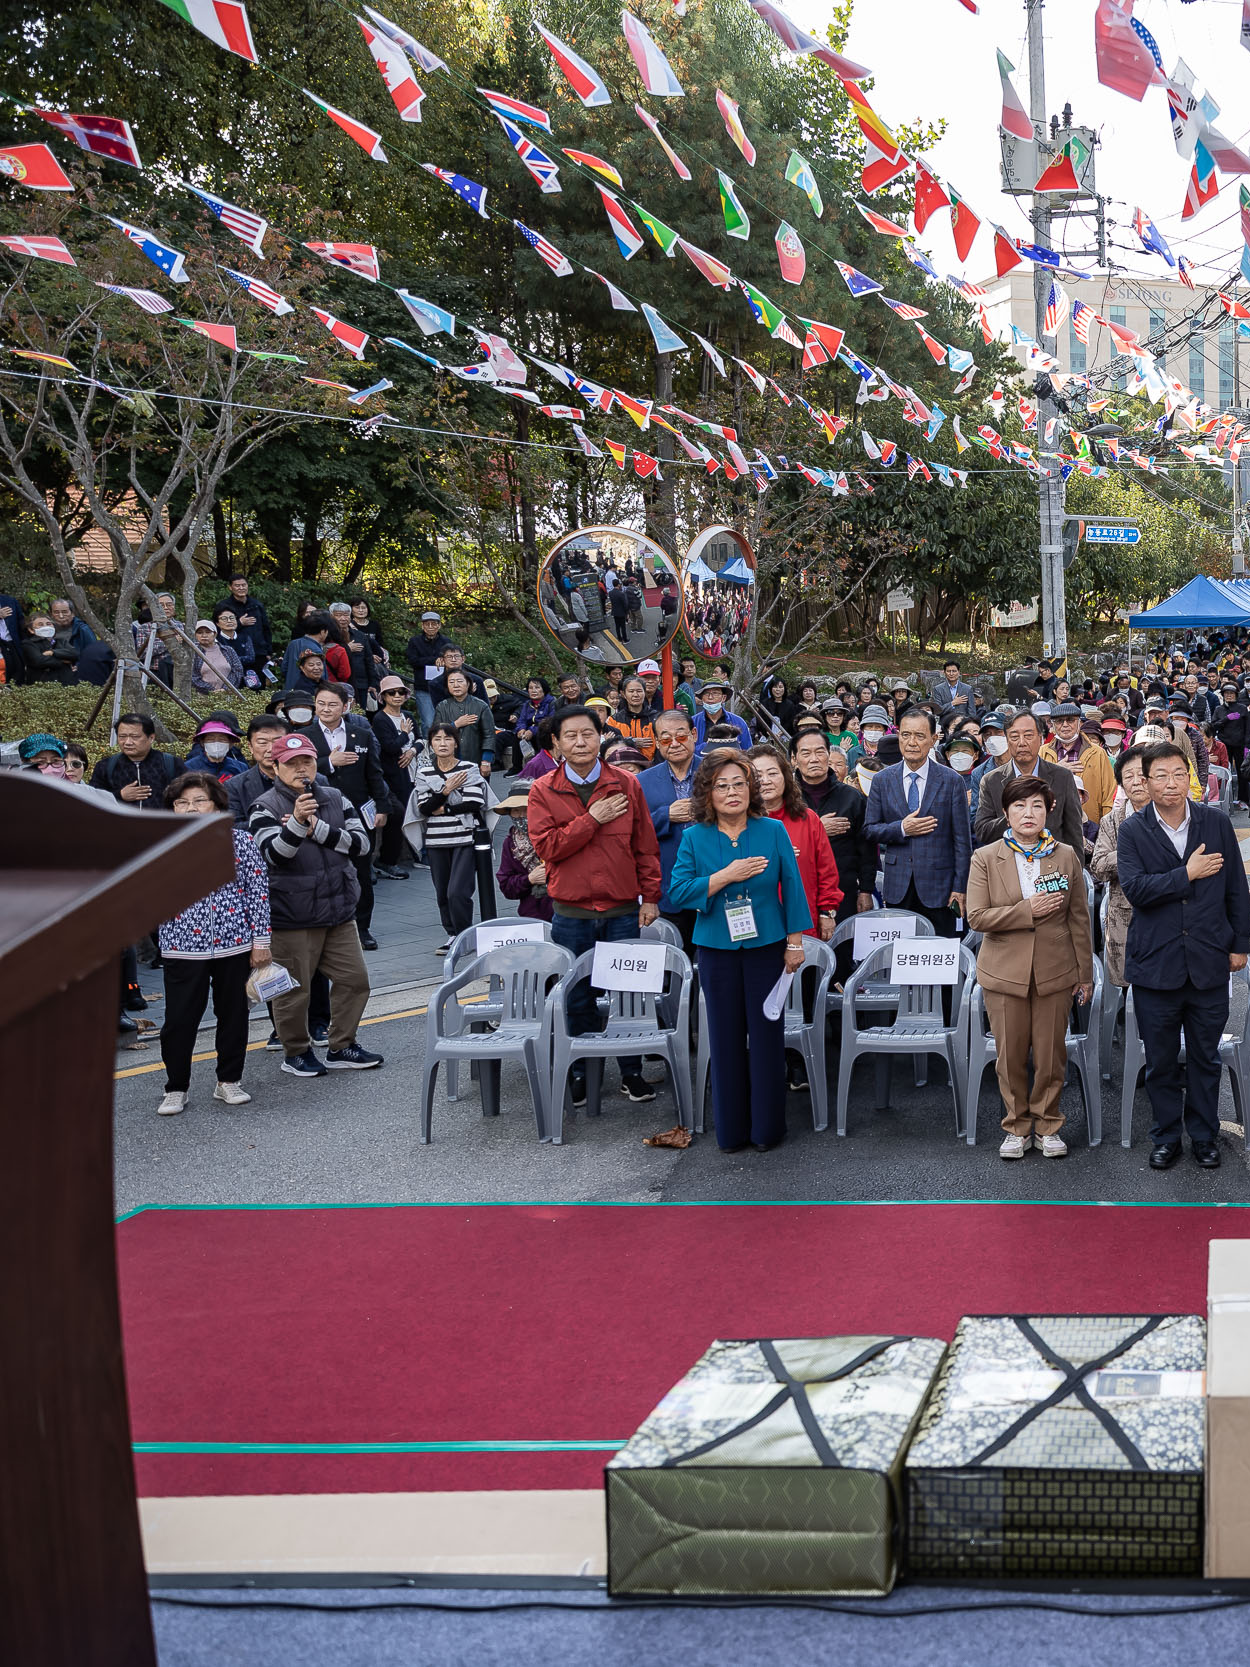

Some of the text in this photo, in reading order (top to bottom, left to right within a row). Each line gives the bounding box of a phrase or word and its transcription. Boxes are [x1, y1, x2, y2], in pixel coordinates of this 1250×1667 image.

[1118, 288, 1172, 302] SEJONG
[610, 958, 648, 972] 시의원
[897, 954, 956, 966] 당협위원장
